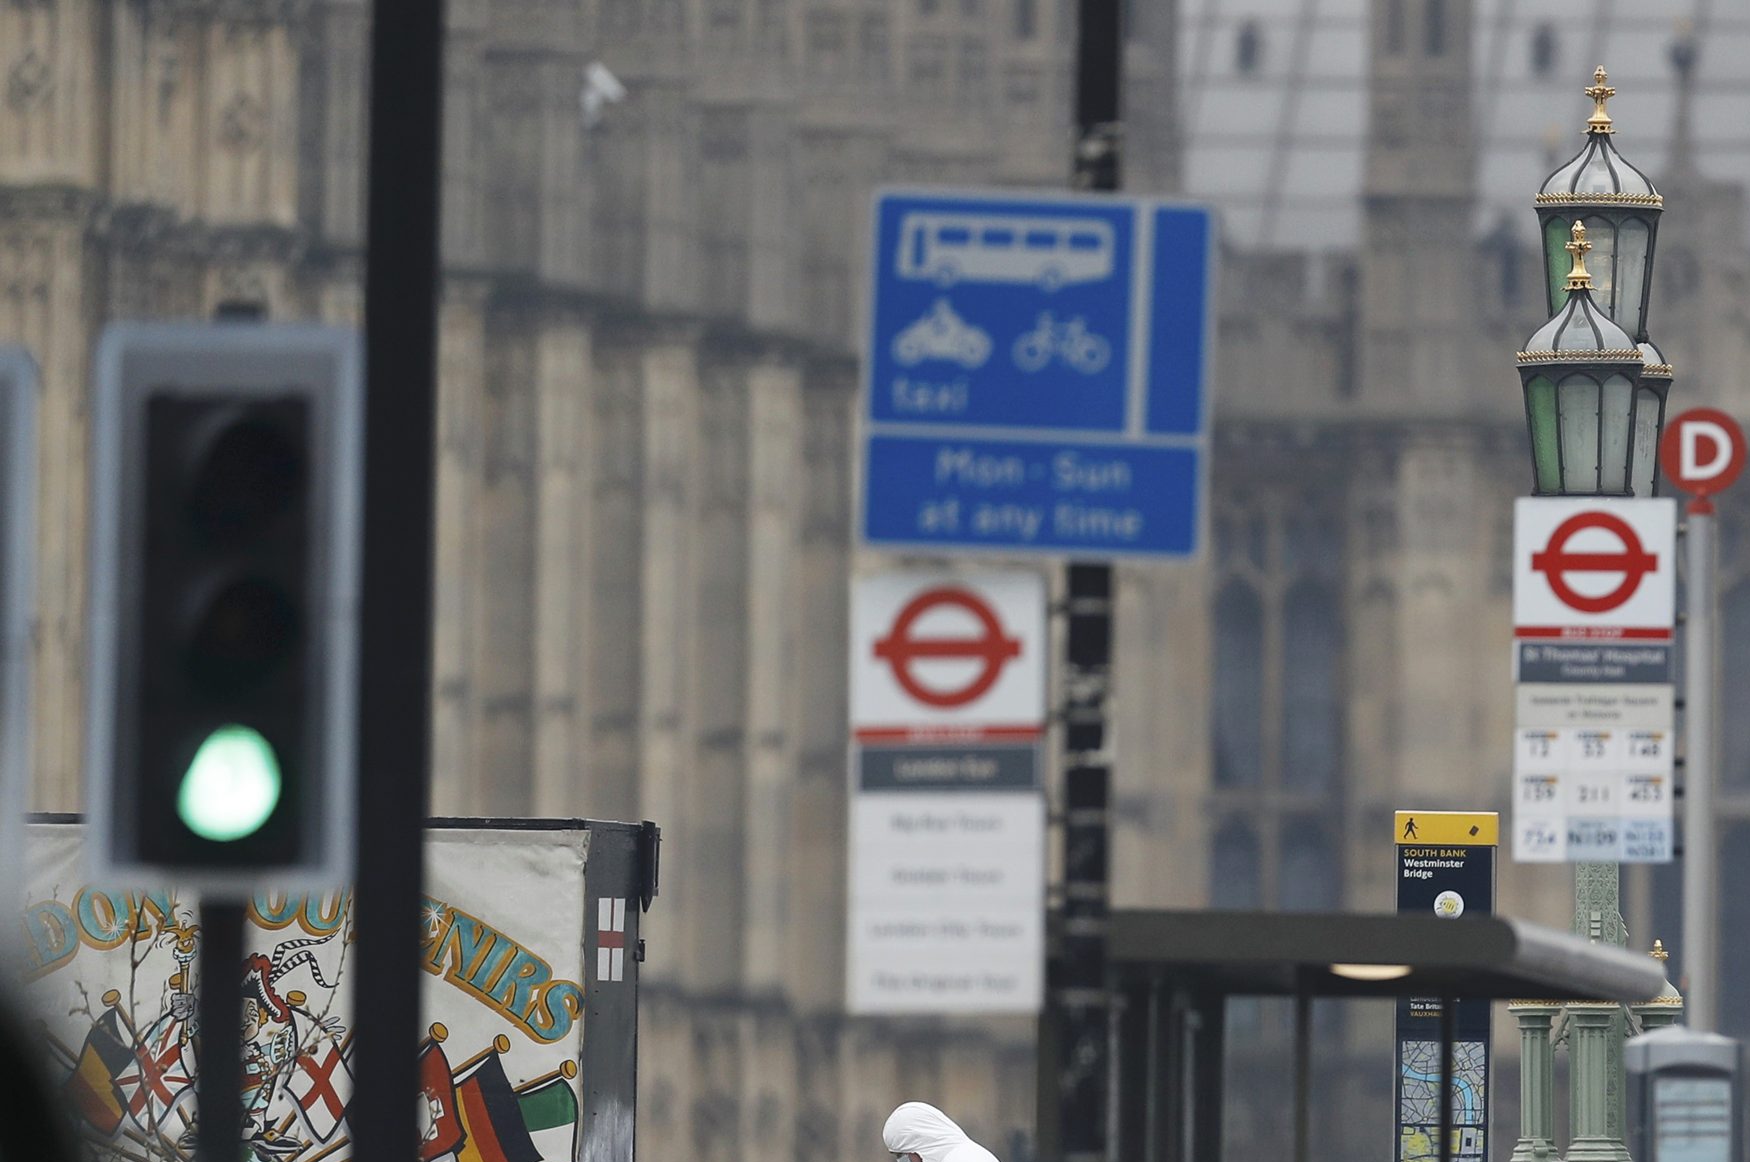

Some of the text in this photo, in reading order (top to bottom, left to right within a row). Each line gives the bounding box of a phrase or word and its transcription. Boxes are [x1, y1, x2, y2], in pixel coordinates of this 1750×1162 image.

[892, 376, 969, 413] taxi
[935, 446, 1025, 488] Mon
[1052, 450, 1132, 491] Sun
[1680, 420, 1733, 480] D
[917, 498, 1144, 540] at any time
[1403, 849, 1467, 858] SOUTH BANK
[1403, 858, 1465, 868] Westminster
[1403, 869, 1433, 880] Bridge
